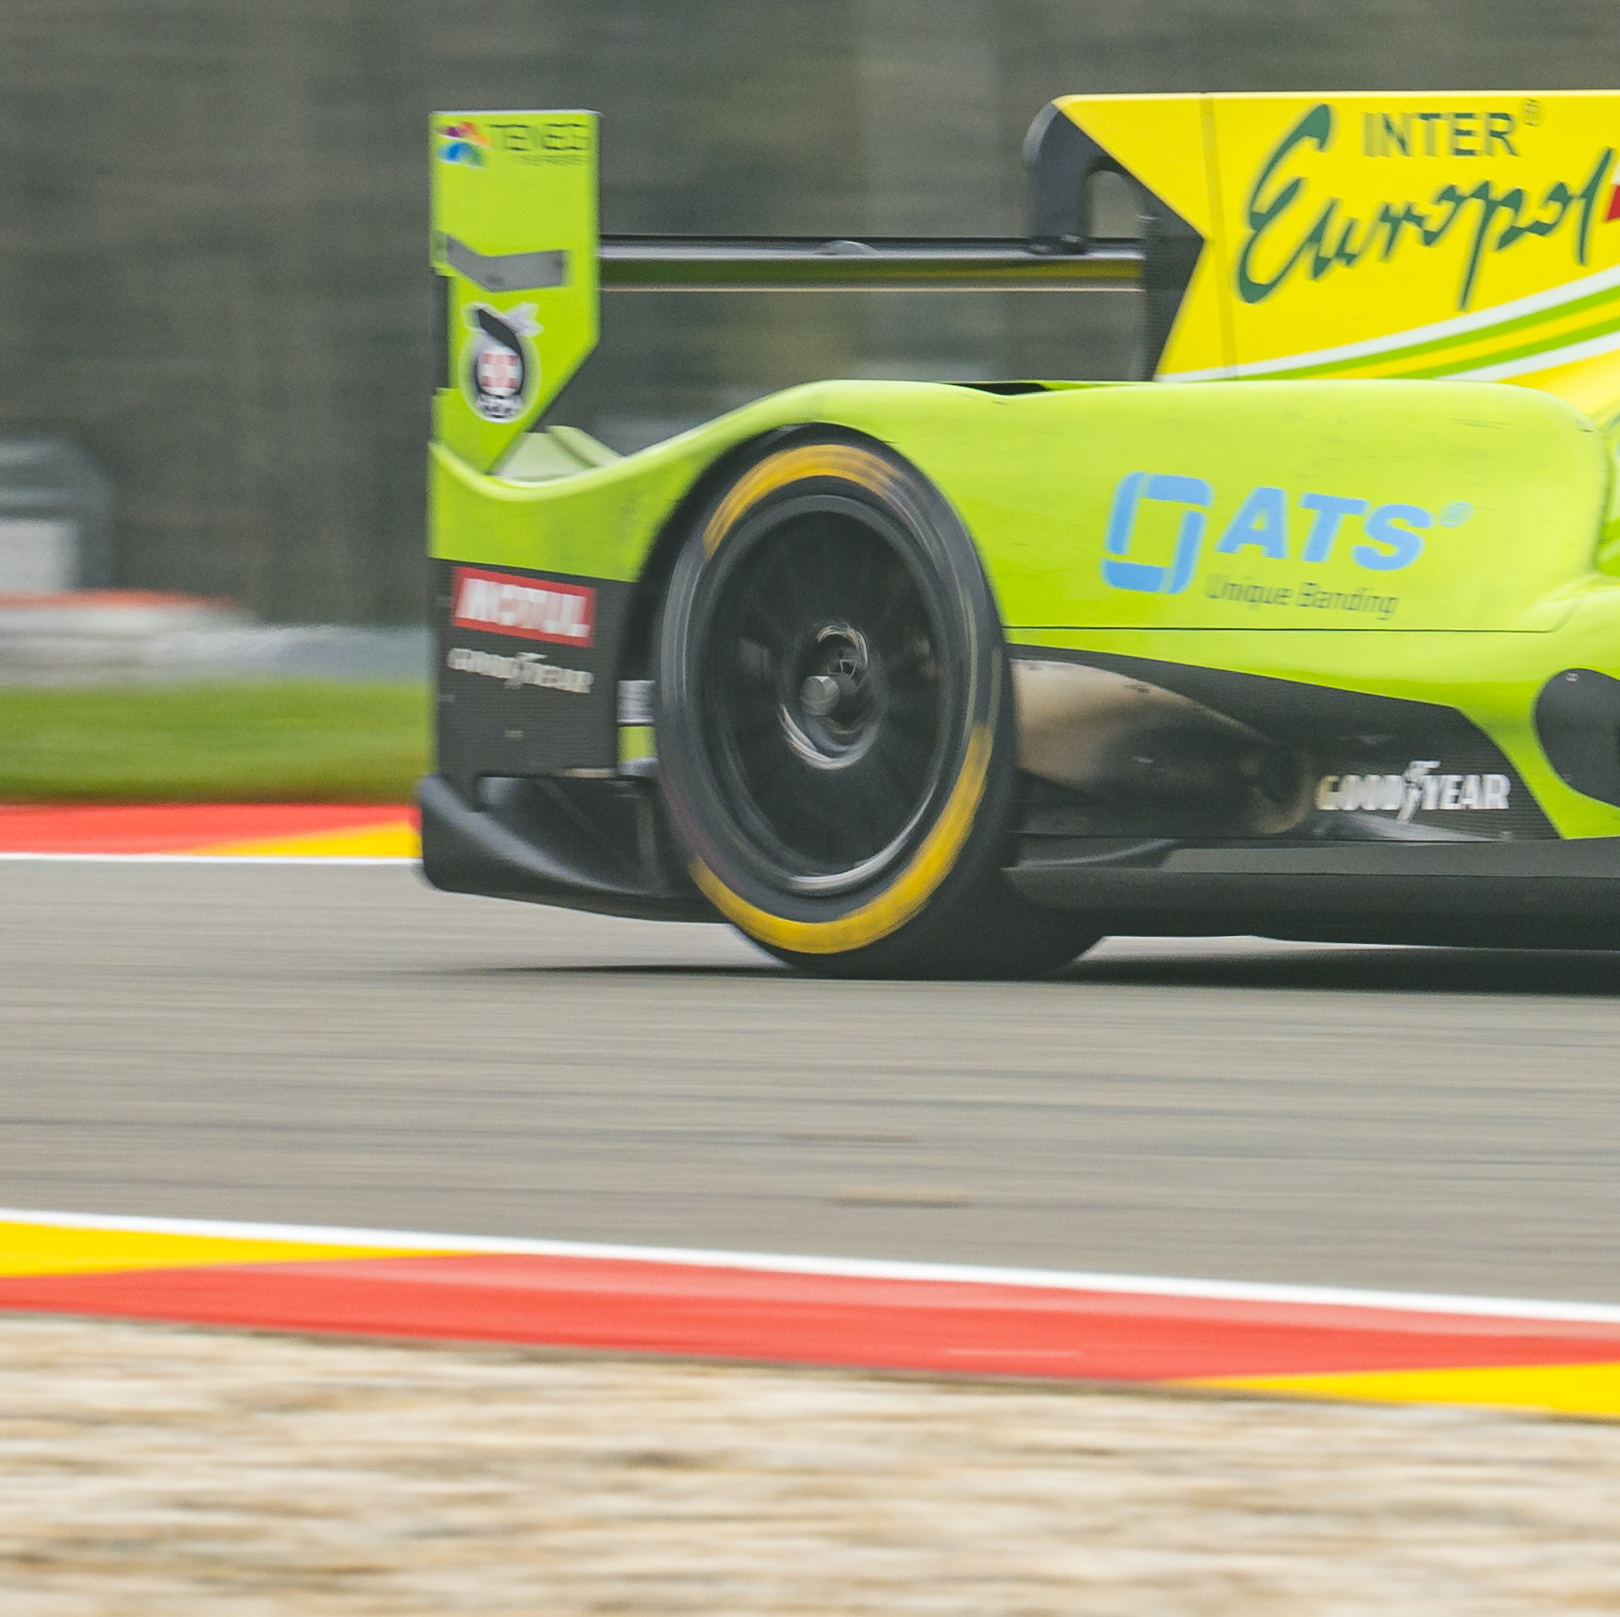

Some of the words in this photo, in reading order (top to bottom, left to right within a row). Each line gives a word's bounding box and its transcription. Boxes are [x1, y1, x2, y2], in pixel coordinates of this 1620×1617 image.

[1362, 111, 1521, 157] INTER
[1235, 102, 1615, 311] Europol
[1213, 485, 1435, 571] ATS
[1203, 572, 1292, 611] Unique
[1298, 581, 1401, 621] Banding
[1315, 770, 1512, 813] GOODYEAR
